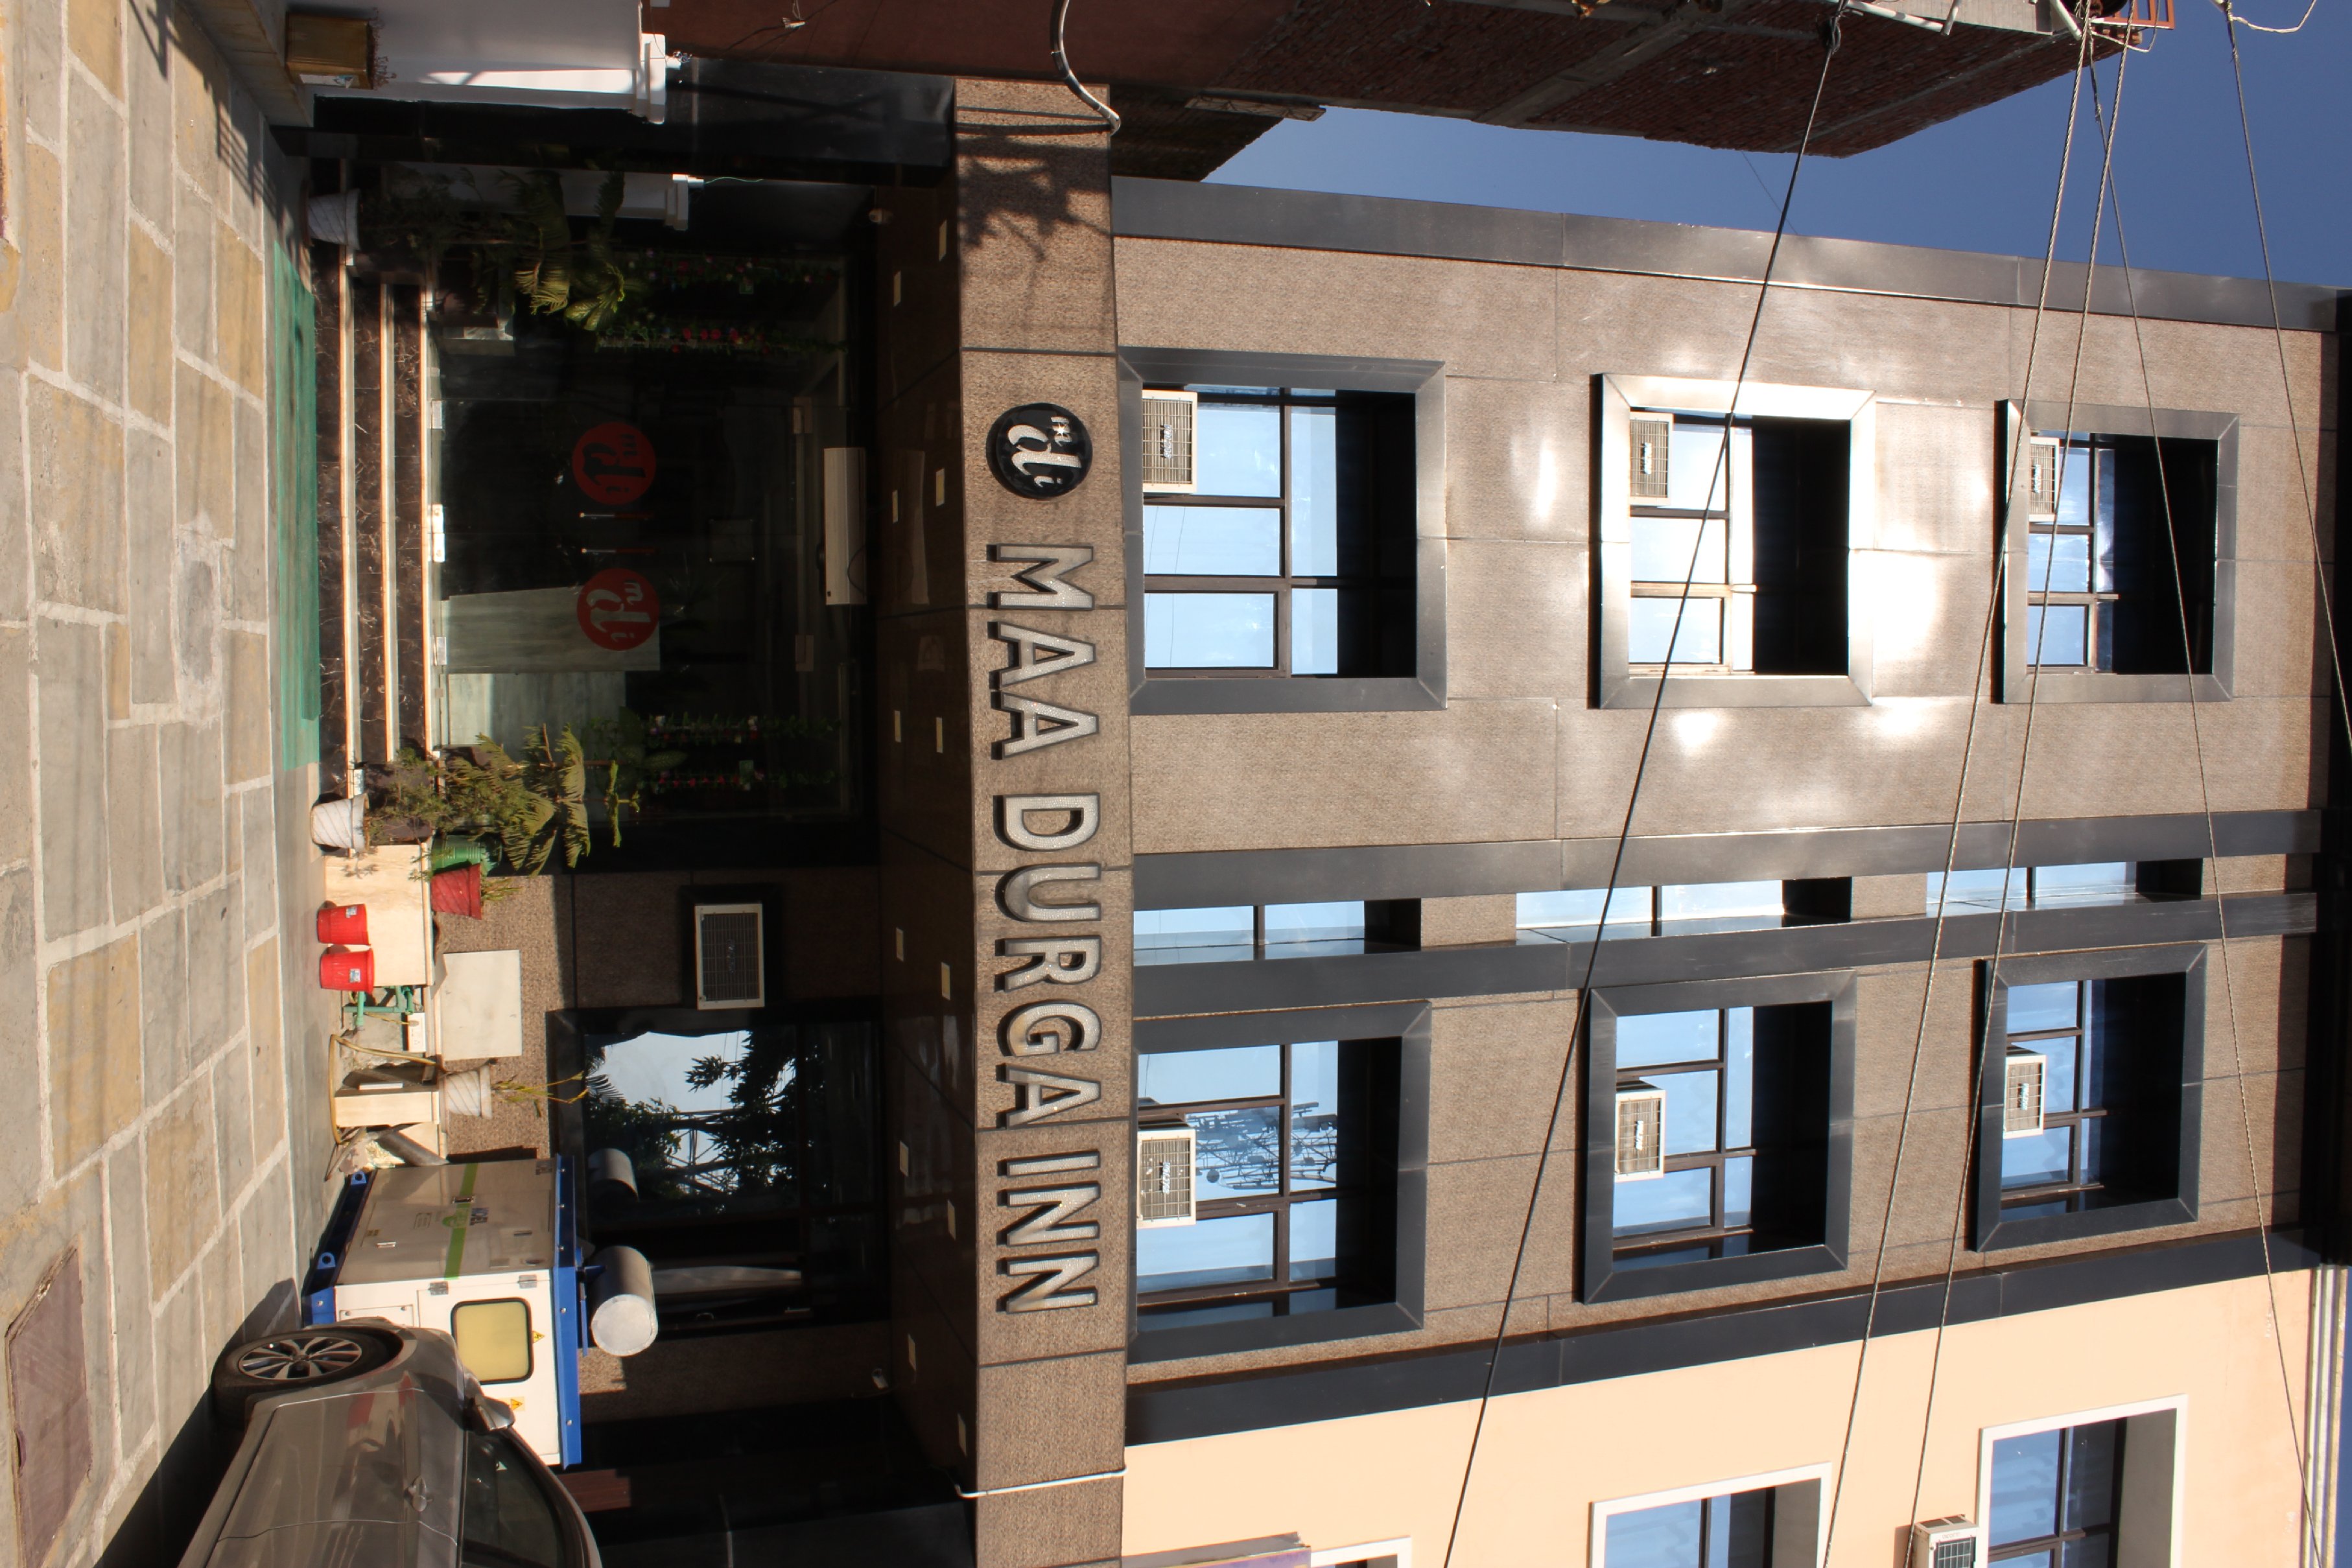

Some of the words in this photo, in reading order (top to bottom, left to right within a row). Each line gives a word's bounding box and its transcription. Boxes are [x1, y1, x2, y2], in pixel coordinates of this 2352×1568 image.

[996, 543, 1100, 760] MAA
[1004, 793, 1102, 1129] DURGA
[1006, 1149, 1101, 1314] INN
